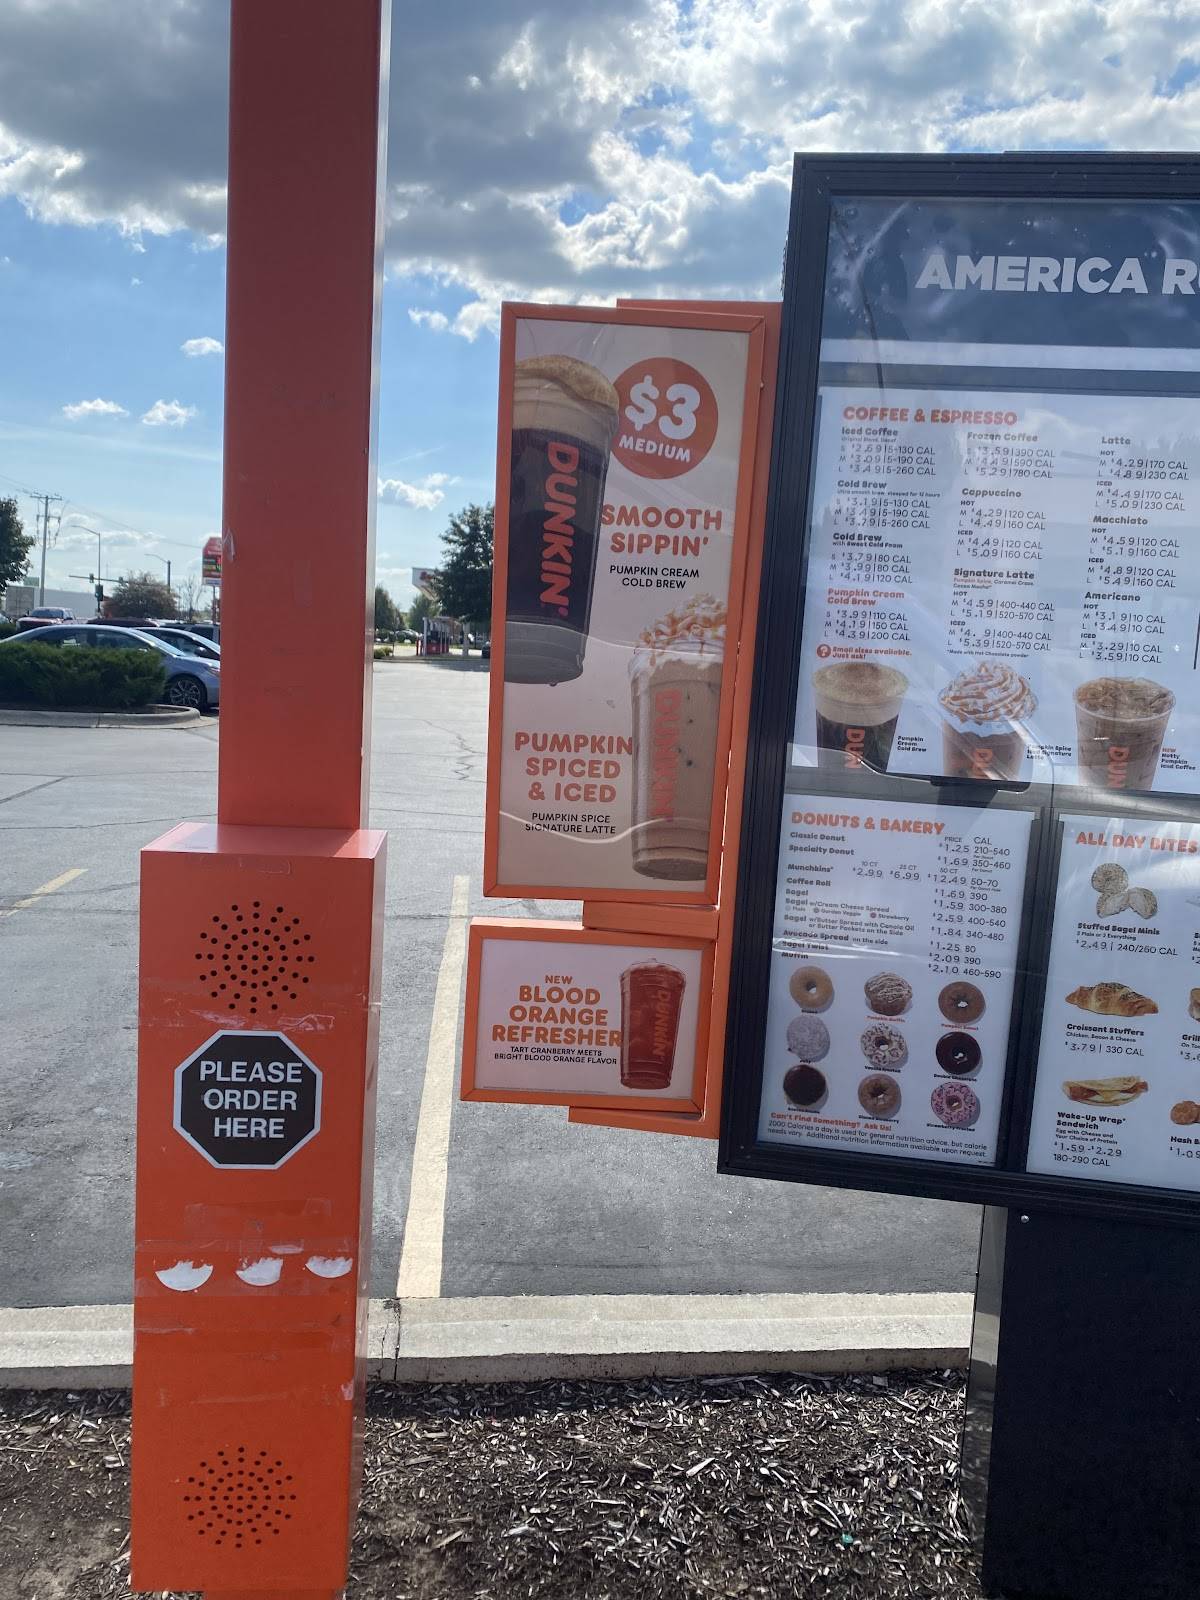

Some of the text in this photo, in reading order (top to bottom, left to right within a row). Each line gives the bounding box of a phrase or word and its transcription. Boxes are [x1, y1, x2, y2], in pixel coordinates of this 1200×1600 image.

[915, 254, 1148, 294] AMERICA
[624, 375, 700, 440] $3
[843, 406, 1017, 425] COFFEE & ESPRESSO
[841, 427, 898, 436] Iced Coffee
[968, 432, 1038, 442] Frozen Coffee
[1102, 436, 1131, 444] Latte
[618, 434, 691, 463] MEDIUM
[916, 447, 936, 455] CAL
[1036, 450, 1055, 458] CAL
[1168, 461, 1188, 470] CAL
[838, 480, 887, 488] Cold Brew
[962, 488, 1022, 498] Cappuccino
[1164, 492, 1184, 500] CAL
[911, 500, 930, 508] CAL
[602, 504, 722, 531] SMOOTH
[1027, 512, 1046, 520] CAL
[1093, 516, 1148, 524] Macchiato
[833, 532, 882, 542] Cold Brew
[610, 532, 709, 556] SIPPIN'
[1024, 541, 1043, 549] CAL
[892, 555, 911, 563] CAL
[610, 564, 700, 578] PUMPKIN CREAM
[954, 568, 1034, 579] Signature Latte
[622, 578, 686, 590] COLD BREW
[828, 588, 904, 598] Pumpkin Cream
[1085, 592, 1140, 601] Americano
[852, 598, 876, 606] Brew
[1038, 603, 1055, 611] CAL
[888, 612, 908, 621] CAL
[1146, 615, 1166, 624] CAL
[1143, 645, 1162, 653] CAL
[515, 732, 632, 755] PUMPKIN
[526, 757, 620, 778] SPICED
[528, 782, 616, 802] & ICED
[532, 812, 610, 824] PUMPKIN SPICE
[792, 812, 945, 835] DONUTS & BAKERY
[525, 824, 616, 834] SIGNATURE LATTE
[790, 832, 846, 842] Classic Donut
[974, 837, 992, 845] CAL
[1076, 832, 1198, 854] ALL DAY BITES
[789, 844, 855, 856] Specialty Donut
[787, 878, 814, 886] Coffee
[786, 888, 808, 897] Bagel
[970, 892, 988, 900] 390
[786, 898, 808, 906] Bagel
[1078, 922, 1110, 931] Stuffed
[1112, 926, 1136, 934] Bagel
[784, 930, 848, 942] Avocado Spread
[1159, 948, 1178, 956] CAL
[964, 957, 981, 965] 390
[545, 975, 572, 984] NEW
[519, 985, 600, 1005] BLOOD
[510, 1005, 608, 1026] ORANGE
[1067, 1024, 1144, 1036] Croissant Stuffers
[492, 1024, 622, 1047] REFRESHER
[530, 1047, 576, 1056] CRANBERRY
[578, 1048, 602, 1056] MEETS
[1106, 1046, 1123, 1054] 330
[1126, 1048, 1144, 1056] CAL
[524, 1054, 550, 1062] BLOOD
[200, 1060, 302, 1083] PLEASE
[204, 1089, 297, 1111] ORDER
[770, 1112, 792, 1120] Can't
[794, 1114, 811, 1122] Find
[814, 1116, 860, 1128] Something?
[864, 1122, 878, 1130] Ask
[1058, 1112, 1097, 1122] Wake-Up
[214, 1118, 284, 1138] HERE
[768, 1120, 814, 1131] 2000 Calories
[1056, 1120, 1099, 1130] Sandwich
[1170, 1136, 1192, 1144] Hash
[1054, 1154, 1110, 1167] 180-290 CAL
